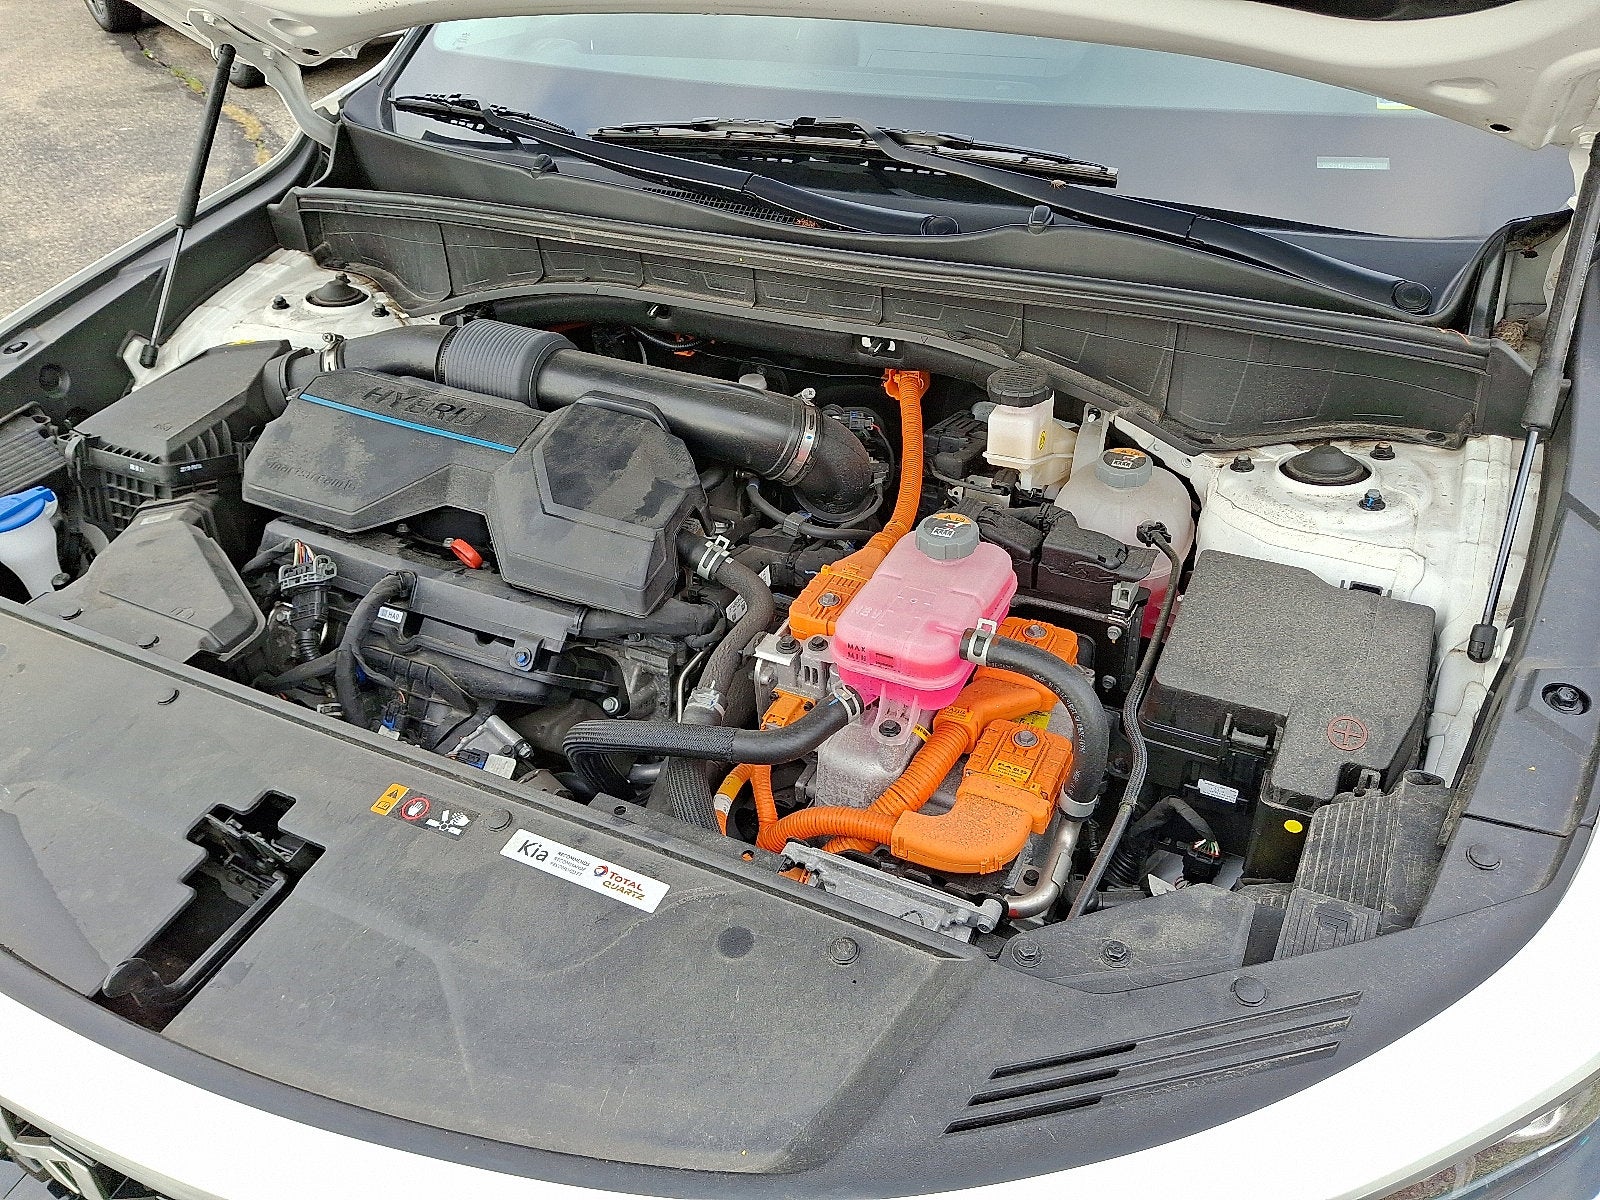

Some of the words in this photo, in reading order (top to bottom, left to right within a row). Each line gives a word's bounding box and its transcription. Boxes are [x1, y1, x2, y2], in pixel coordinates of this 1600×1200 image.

[361, 386, 487, 427] HYBRID
[847, 642, 866, 653] MAX
[847, 651, 867, 662] MIN
[517, 839, 549, 863] Kia
[602, 880, 646, 901] QUARTZ
[609, 870, 643, 892] TOTAL
